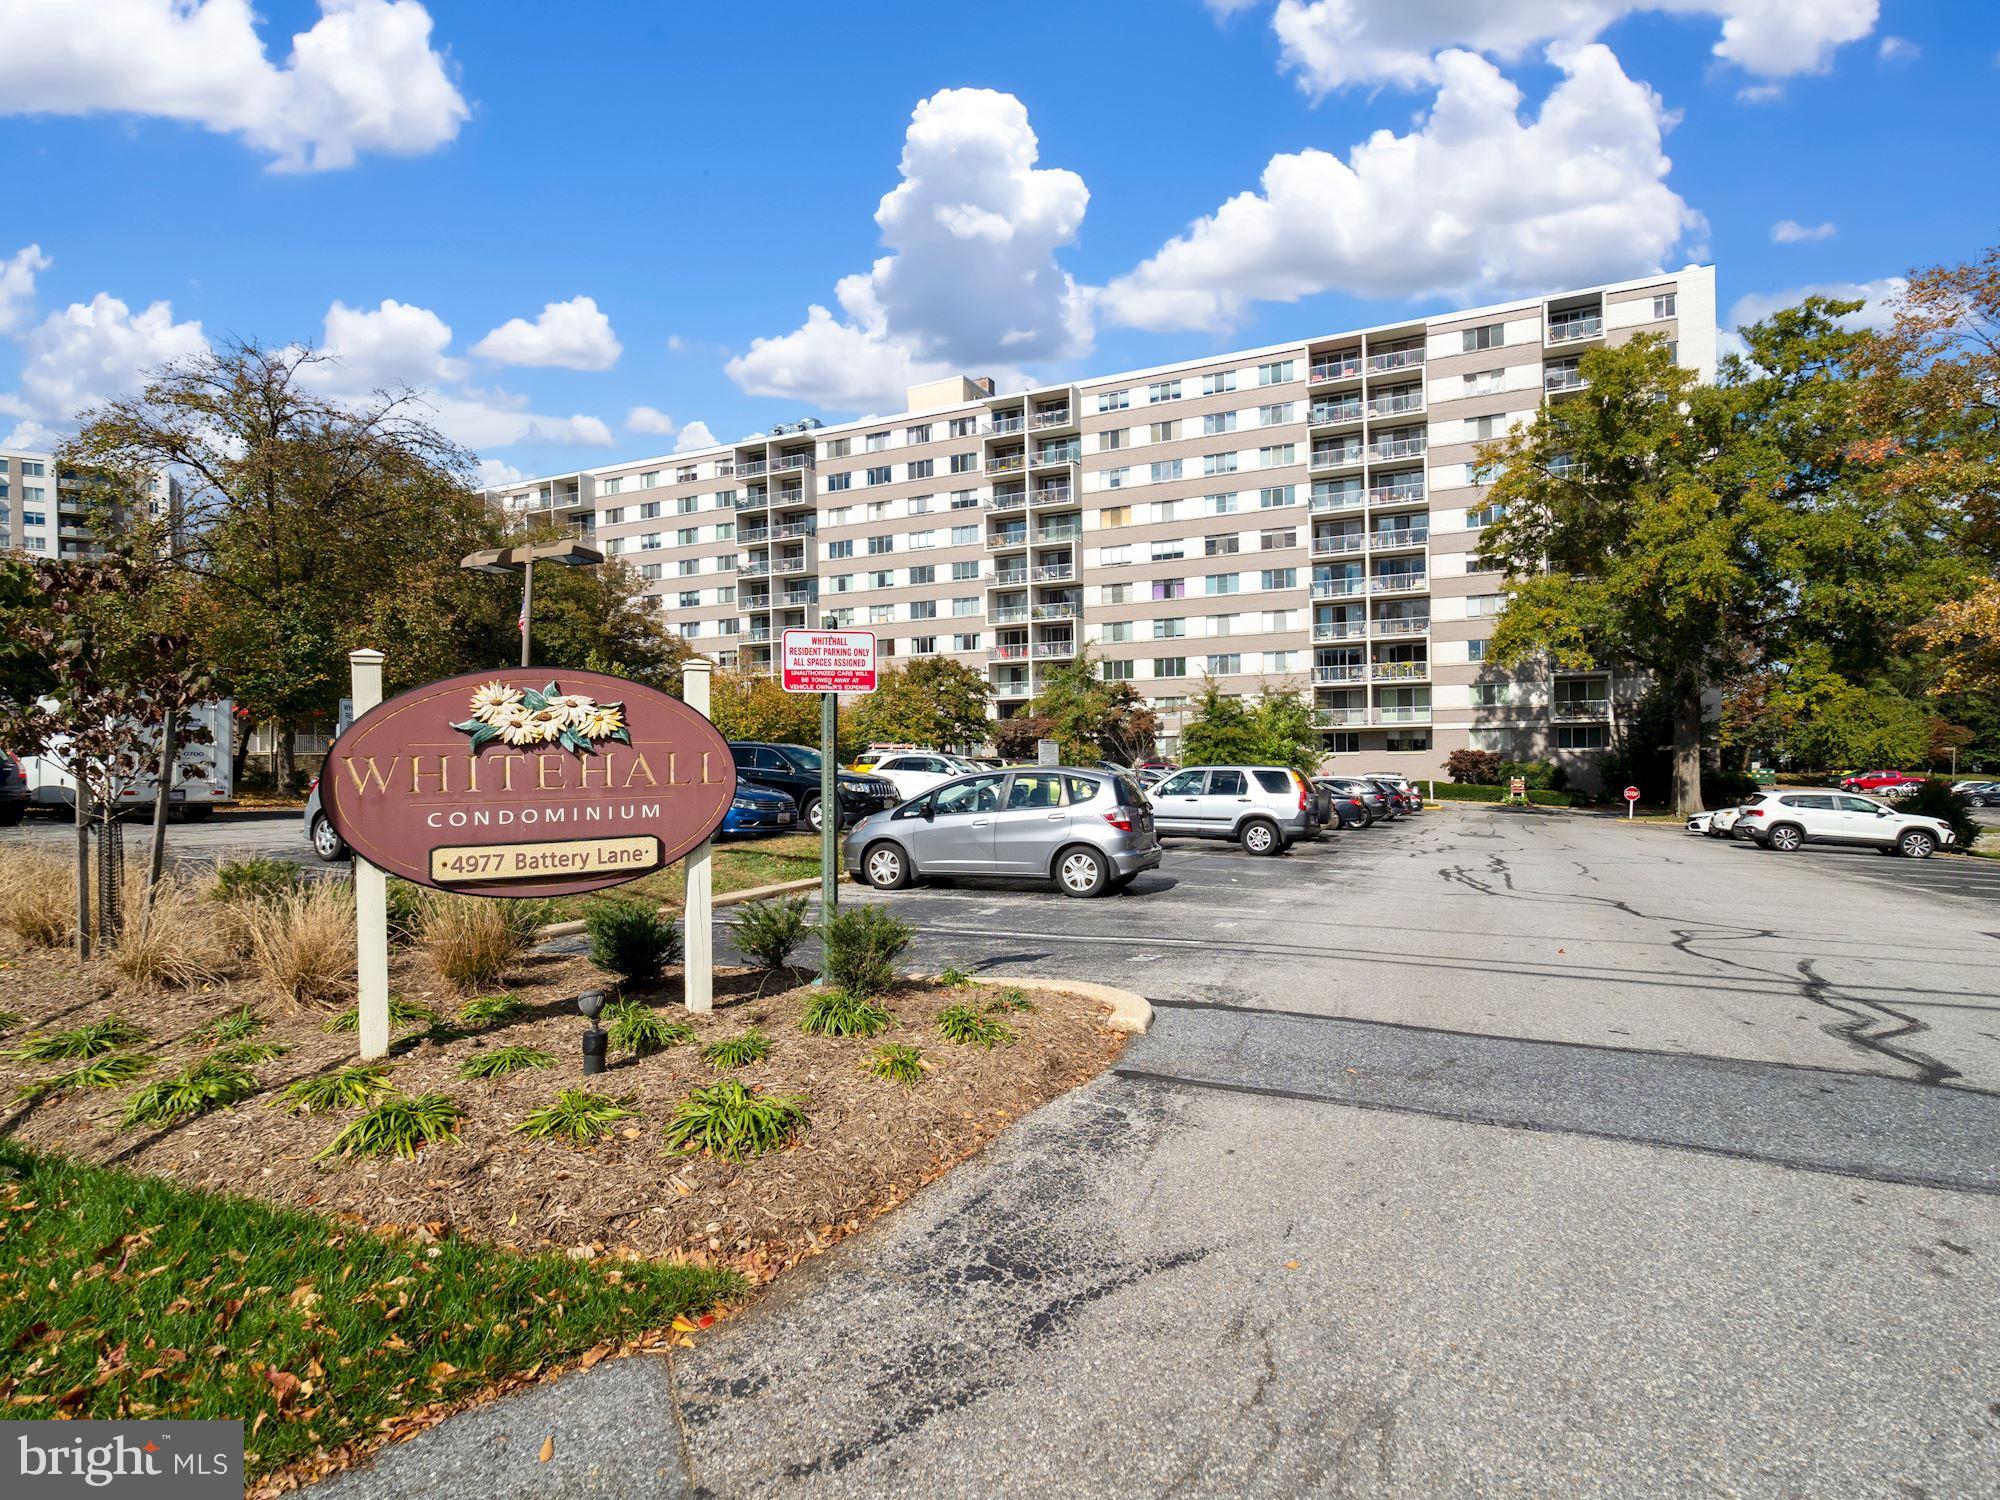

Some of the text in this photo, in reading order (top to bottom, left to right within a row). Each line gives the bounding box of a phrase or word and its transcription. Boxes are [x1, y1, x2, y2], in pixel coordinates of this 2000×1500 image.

[811, 637, 848, 646] WHITEHALL
[789, 648, 870, 657] RESIDENT PARKING ONLY
[793, 658, 866, 667] ALL SPACES ASSIGNED
[338, 750, 727, 796] WHITEHALL
[426, 803, 661, 829] CONDOMINIUM
[450, 847, 643, 874] 4977 Battery Lane
